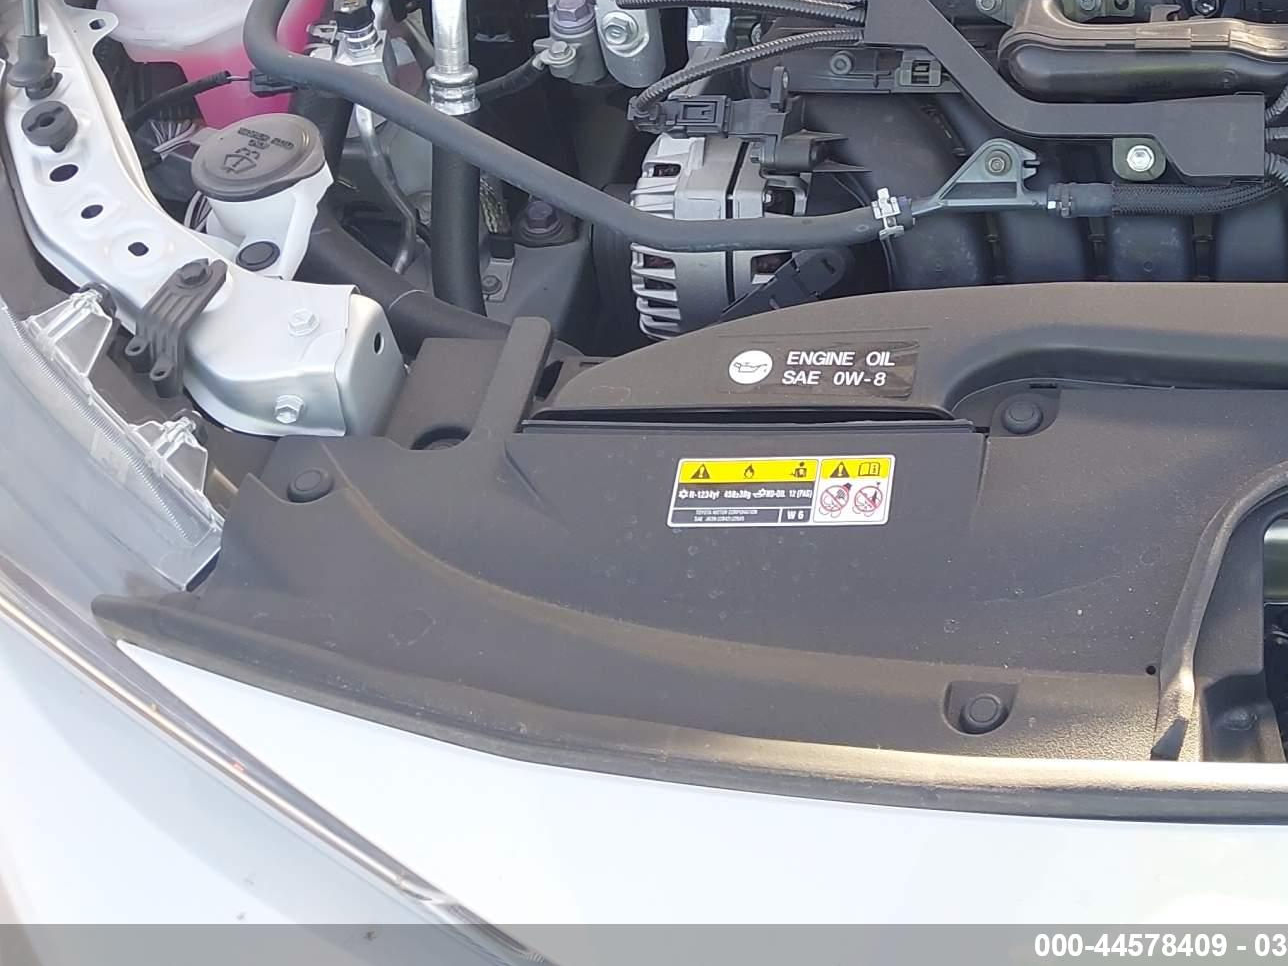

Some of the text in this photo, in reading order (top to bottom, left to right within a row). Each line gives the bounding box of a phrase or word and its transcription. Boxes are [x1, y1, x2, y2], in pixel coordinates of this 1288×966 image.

[786, 351, 896, 367] ENGINE OIL
[782, 370, 886, 387] SAE 0W-8
